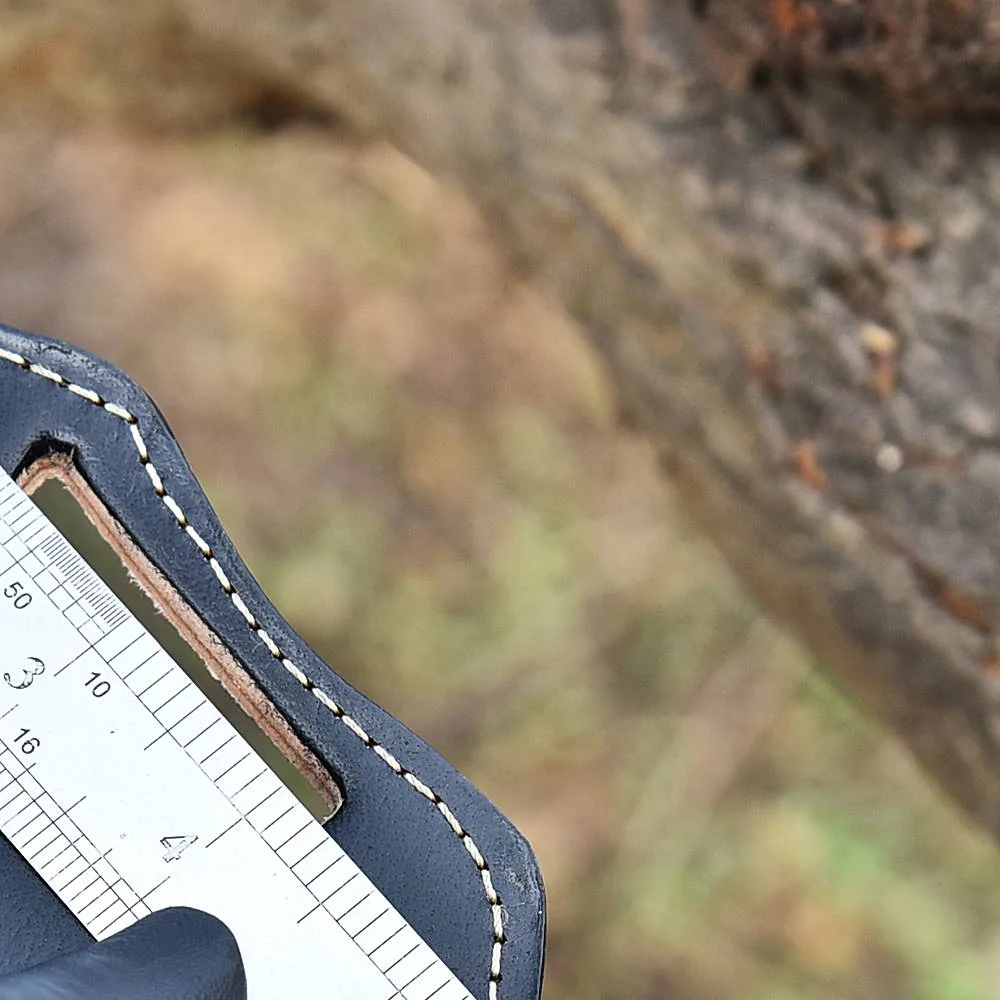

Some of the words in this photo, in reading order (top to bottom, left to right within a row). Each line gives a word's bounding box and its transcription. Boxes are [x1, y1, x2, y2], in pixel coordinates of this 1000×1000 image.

[3, 581, 33, 610] 50
[3, 656, 46, 689] 3
[84, 671, 112, 698] 10
[13, 727, 41, 755] 16
[159, 834, 199, 863] 4
